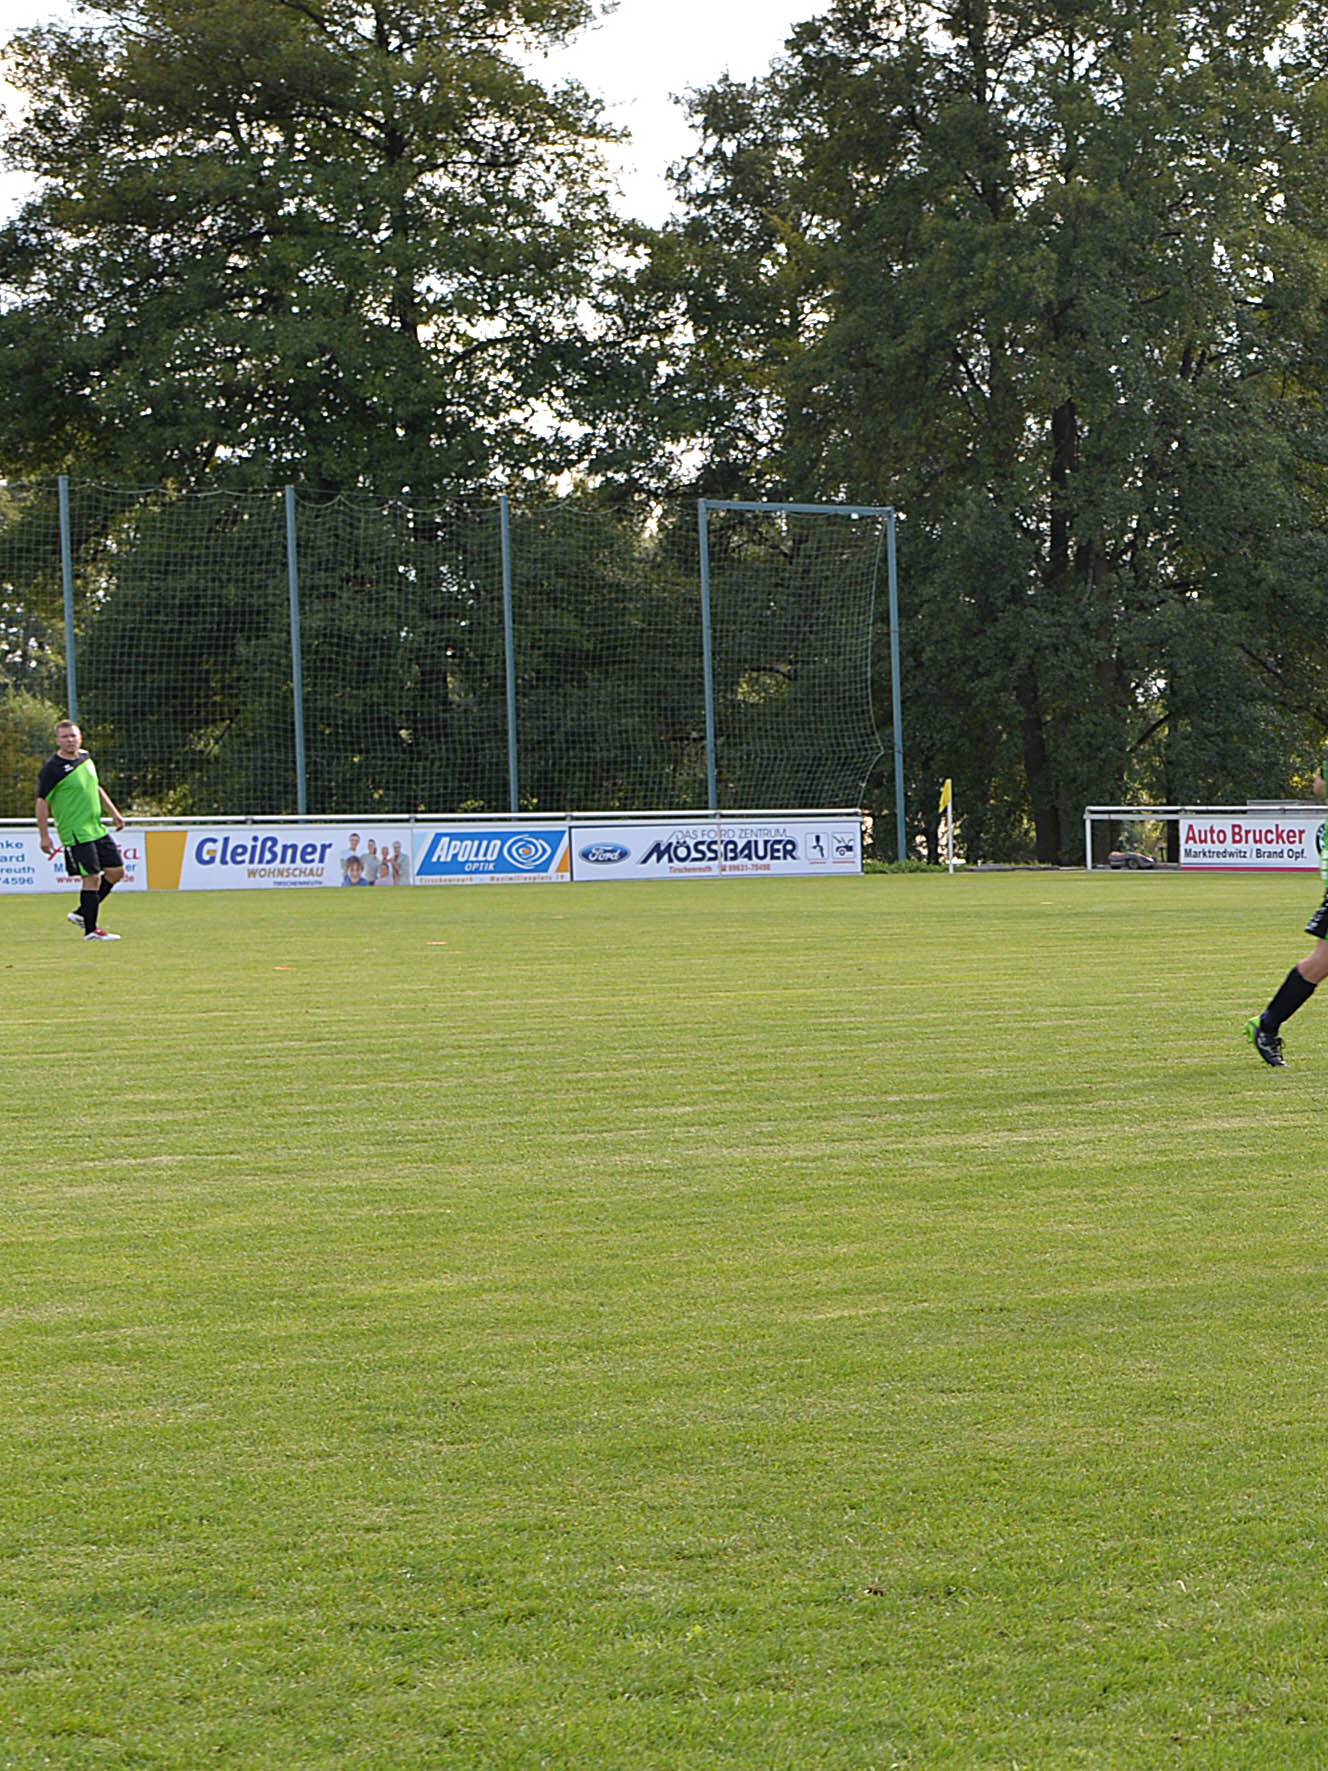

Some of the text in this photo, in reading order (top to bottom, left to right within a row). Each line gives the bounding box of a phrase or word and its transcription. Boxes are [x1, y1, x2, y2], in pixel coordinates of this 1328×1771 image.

[675, 828, 787, 841] DAS FORD ZENTRUM
[1185, 824, 1305, 844] Auto Brucker
[195, 835, 332, 866] Gleißner
[431, 836, 501, 863] APOLLO
[588, 846, 620, 861] Ford
[639, 839, 798, 865] MÖSSBAUER
[1184, 848, 1248, 858] Marktredwitz
[1257, 848, 1283, 859] Brand
[1287, 848, 1307, 861] Opf.
[247, 867, 324, 879] WOHNSCHAU
[464, 862, 496, 872] OPTIK
[0, 877, 35, 886] 4596
